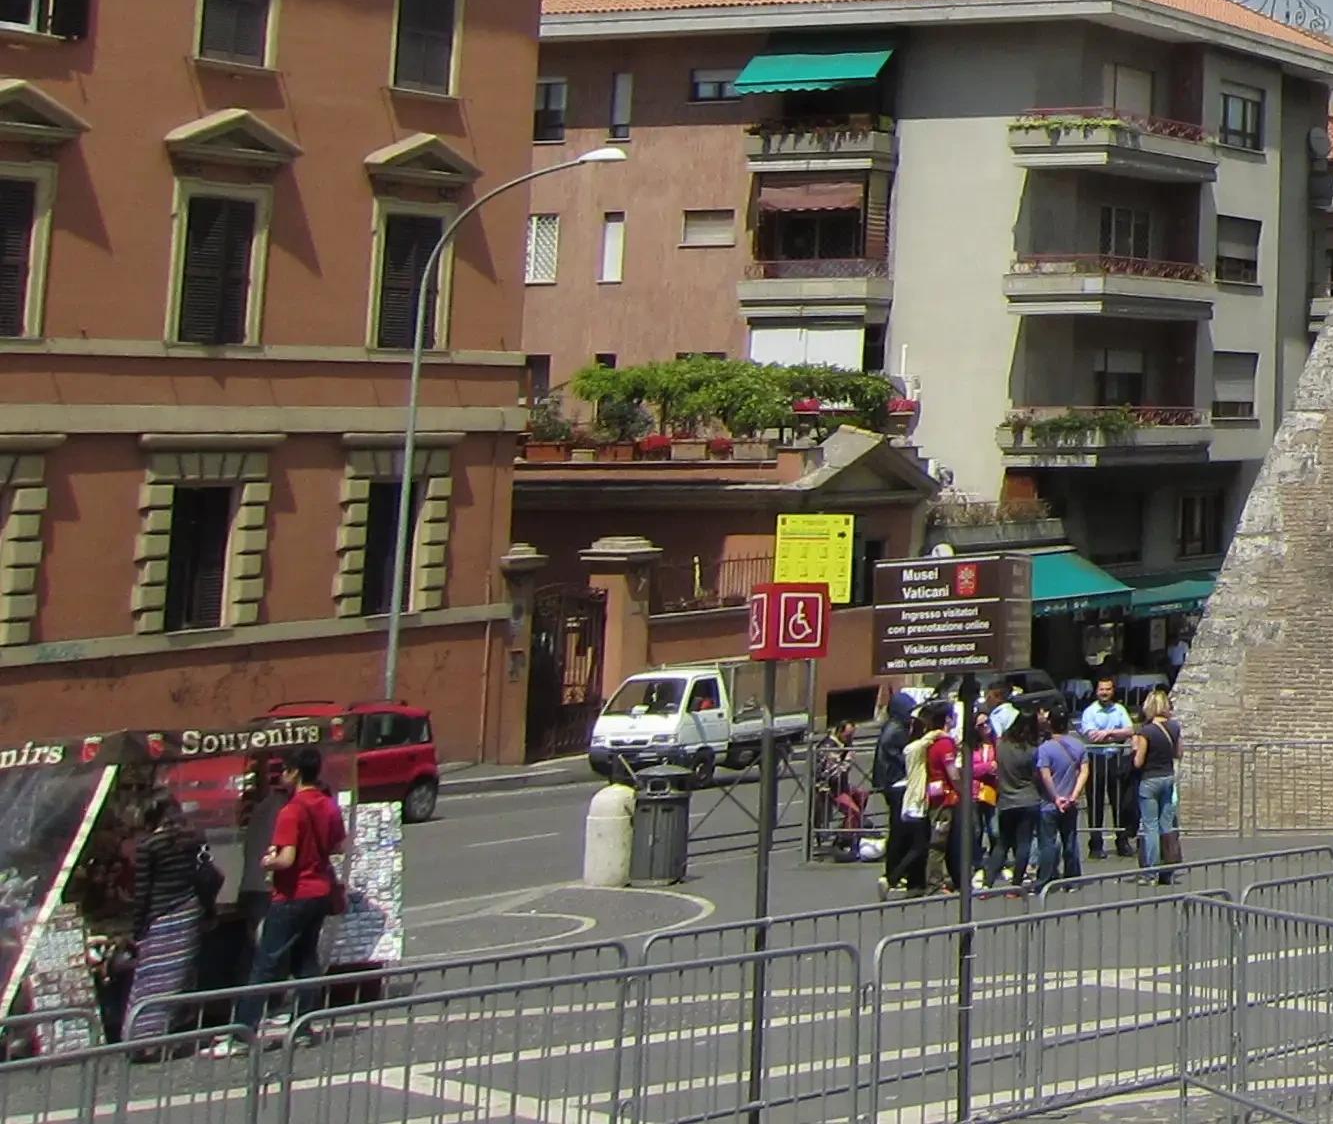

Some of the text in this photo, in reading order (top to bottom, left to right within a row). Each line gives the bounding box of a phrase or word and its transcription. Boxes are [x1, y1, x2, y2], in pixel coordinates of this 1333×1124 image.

[902, 567, 938, 582] Musei
[902, 584, 950, 600] Vaticani
[901, 606, 978, 622] Ingresso visitatori
[903, 642, 975, 655] Visitors entrance
[181, 722, 320, 755] Souvenirs
